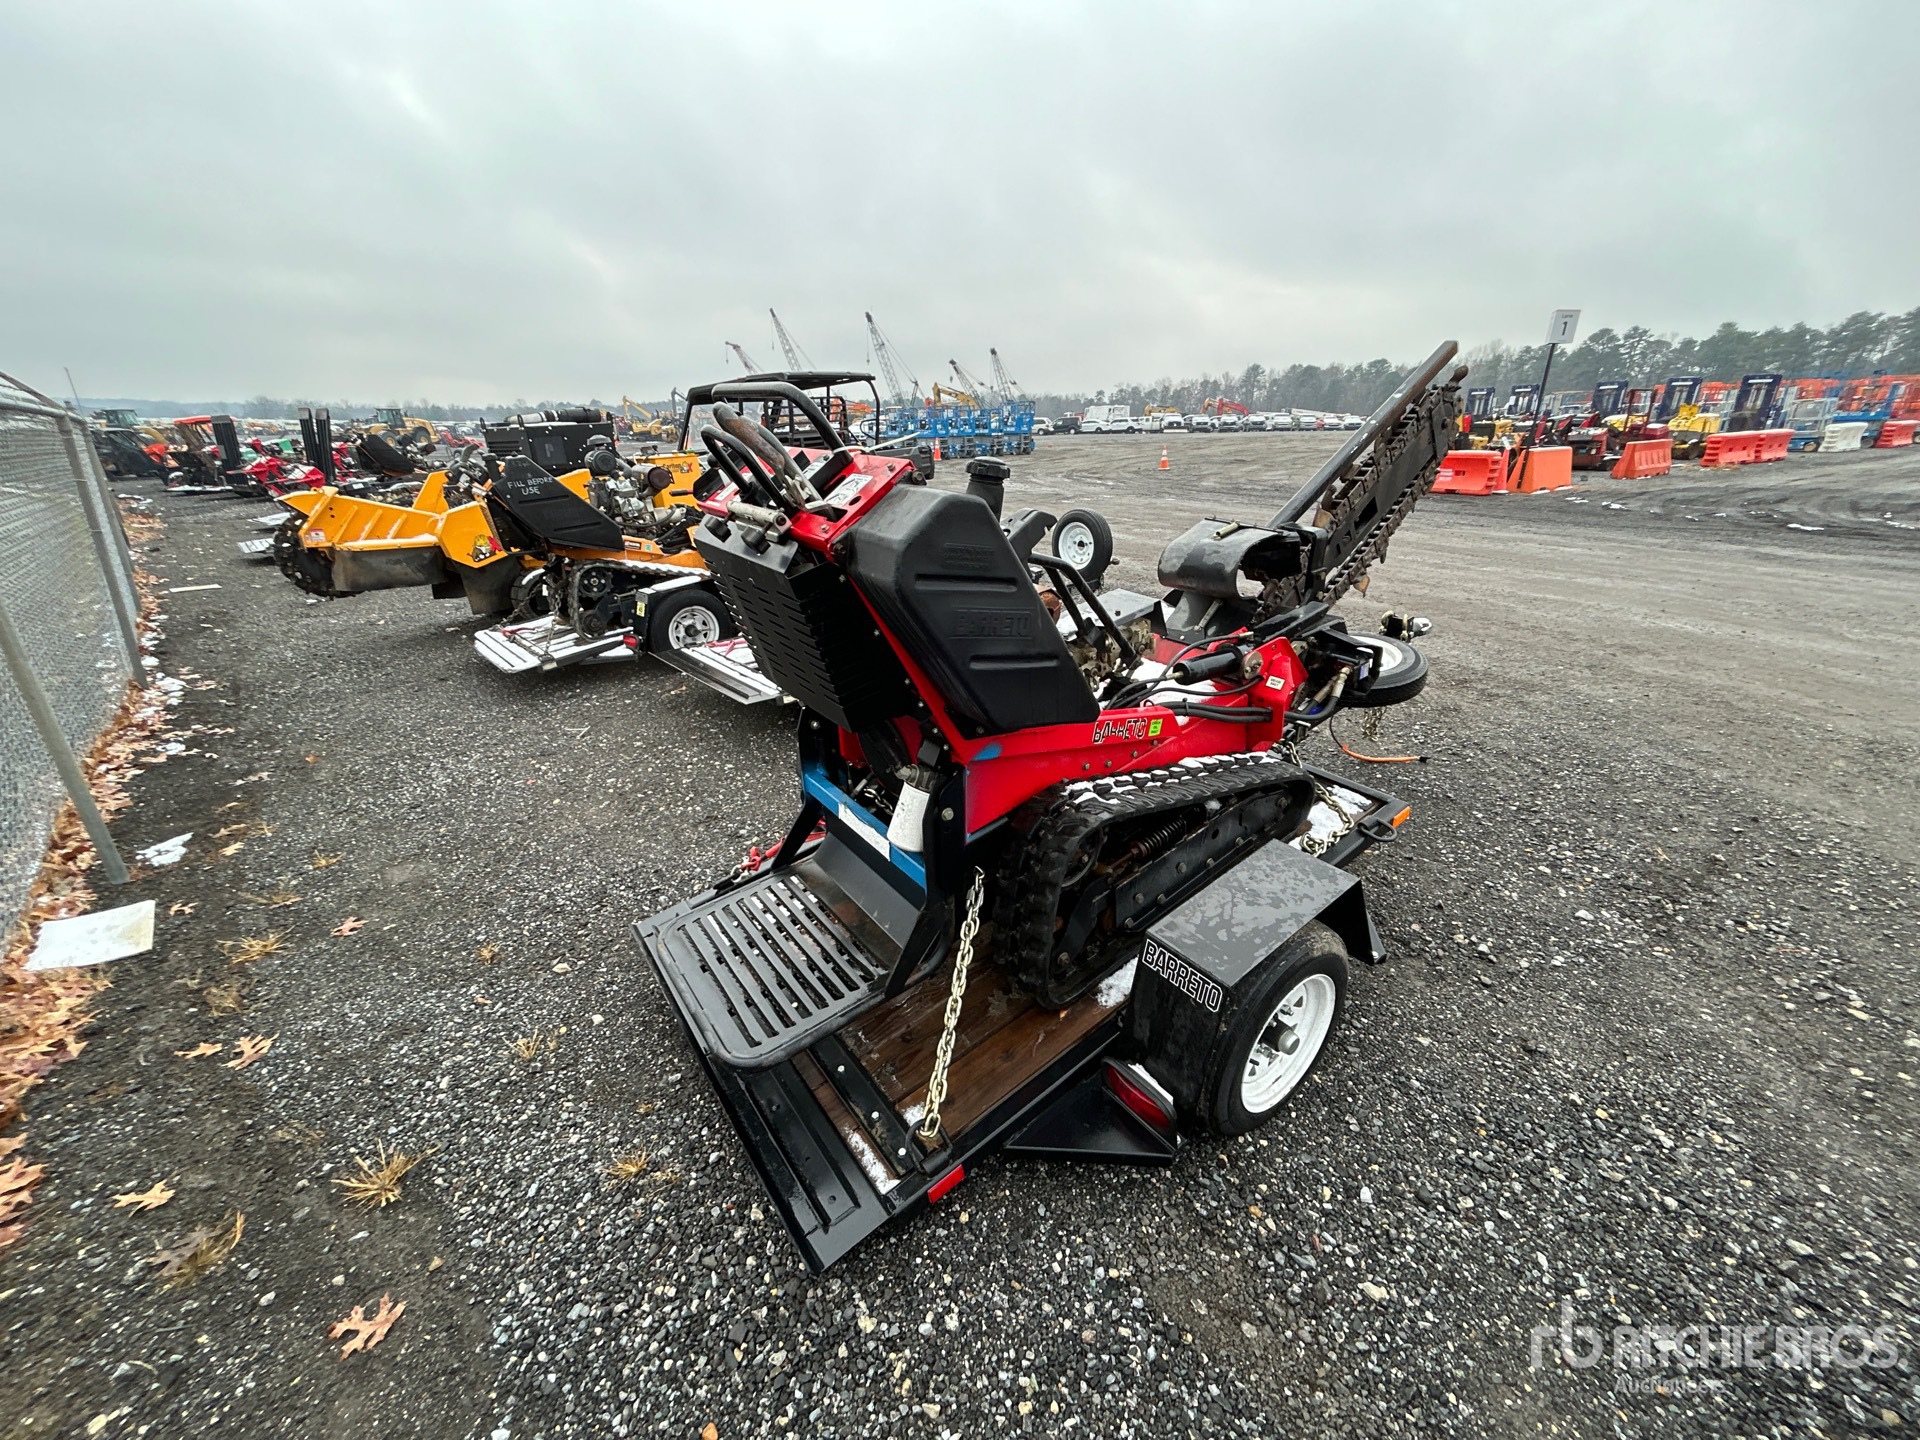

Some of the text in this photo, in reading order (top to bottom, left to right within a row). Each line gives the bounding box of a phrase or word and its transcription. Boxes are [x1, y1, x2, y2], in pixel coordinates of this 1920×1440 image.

[1561, 321, 1568, 336] 1
[507, 476, 553, 489] FILL BEFORE
[521, 486, 540, 496] USE
[1141, 938, 1223, 1013] BARRETO
